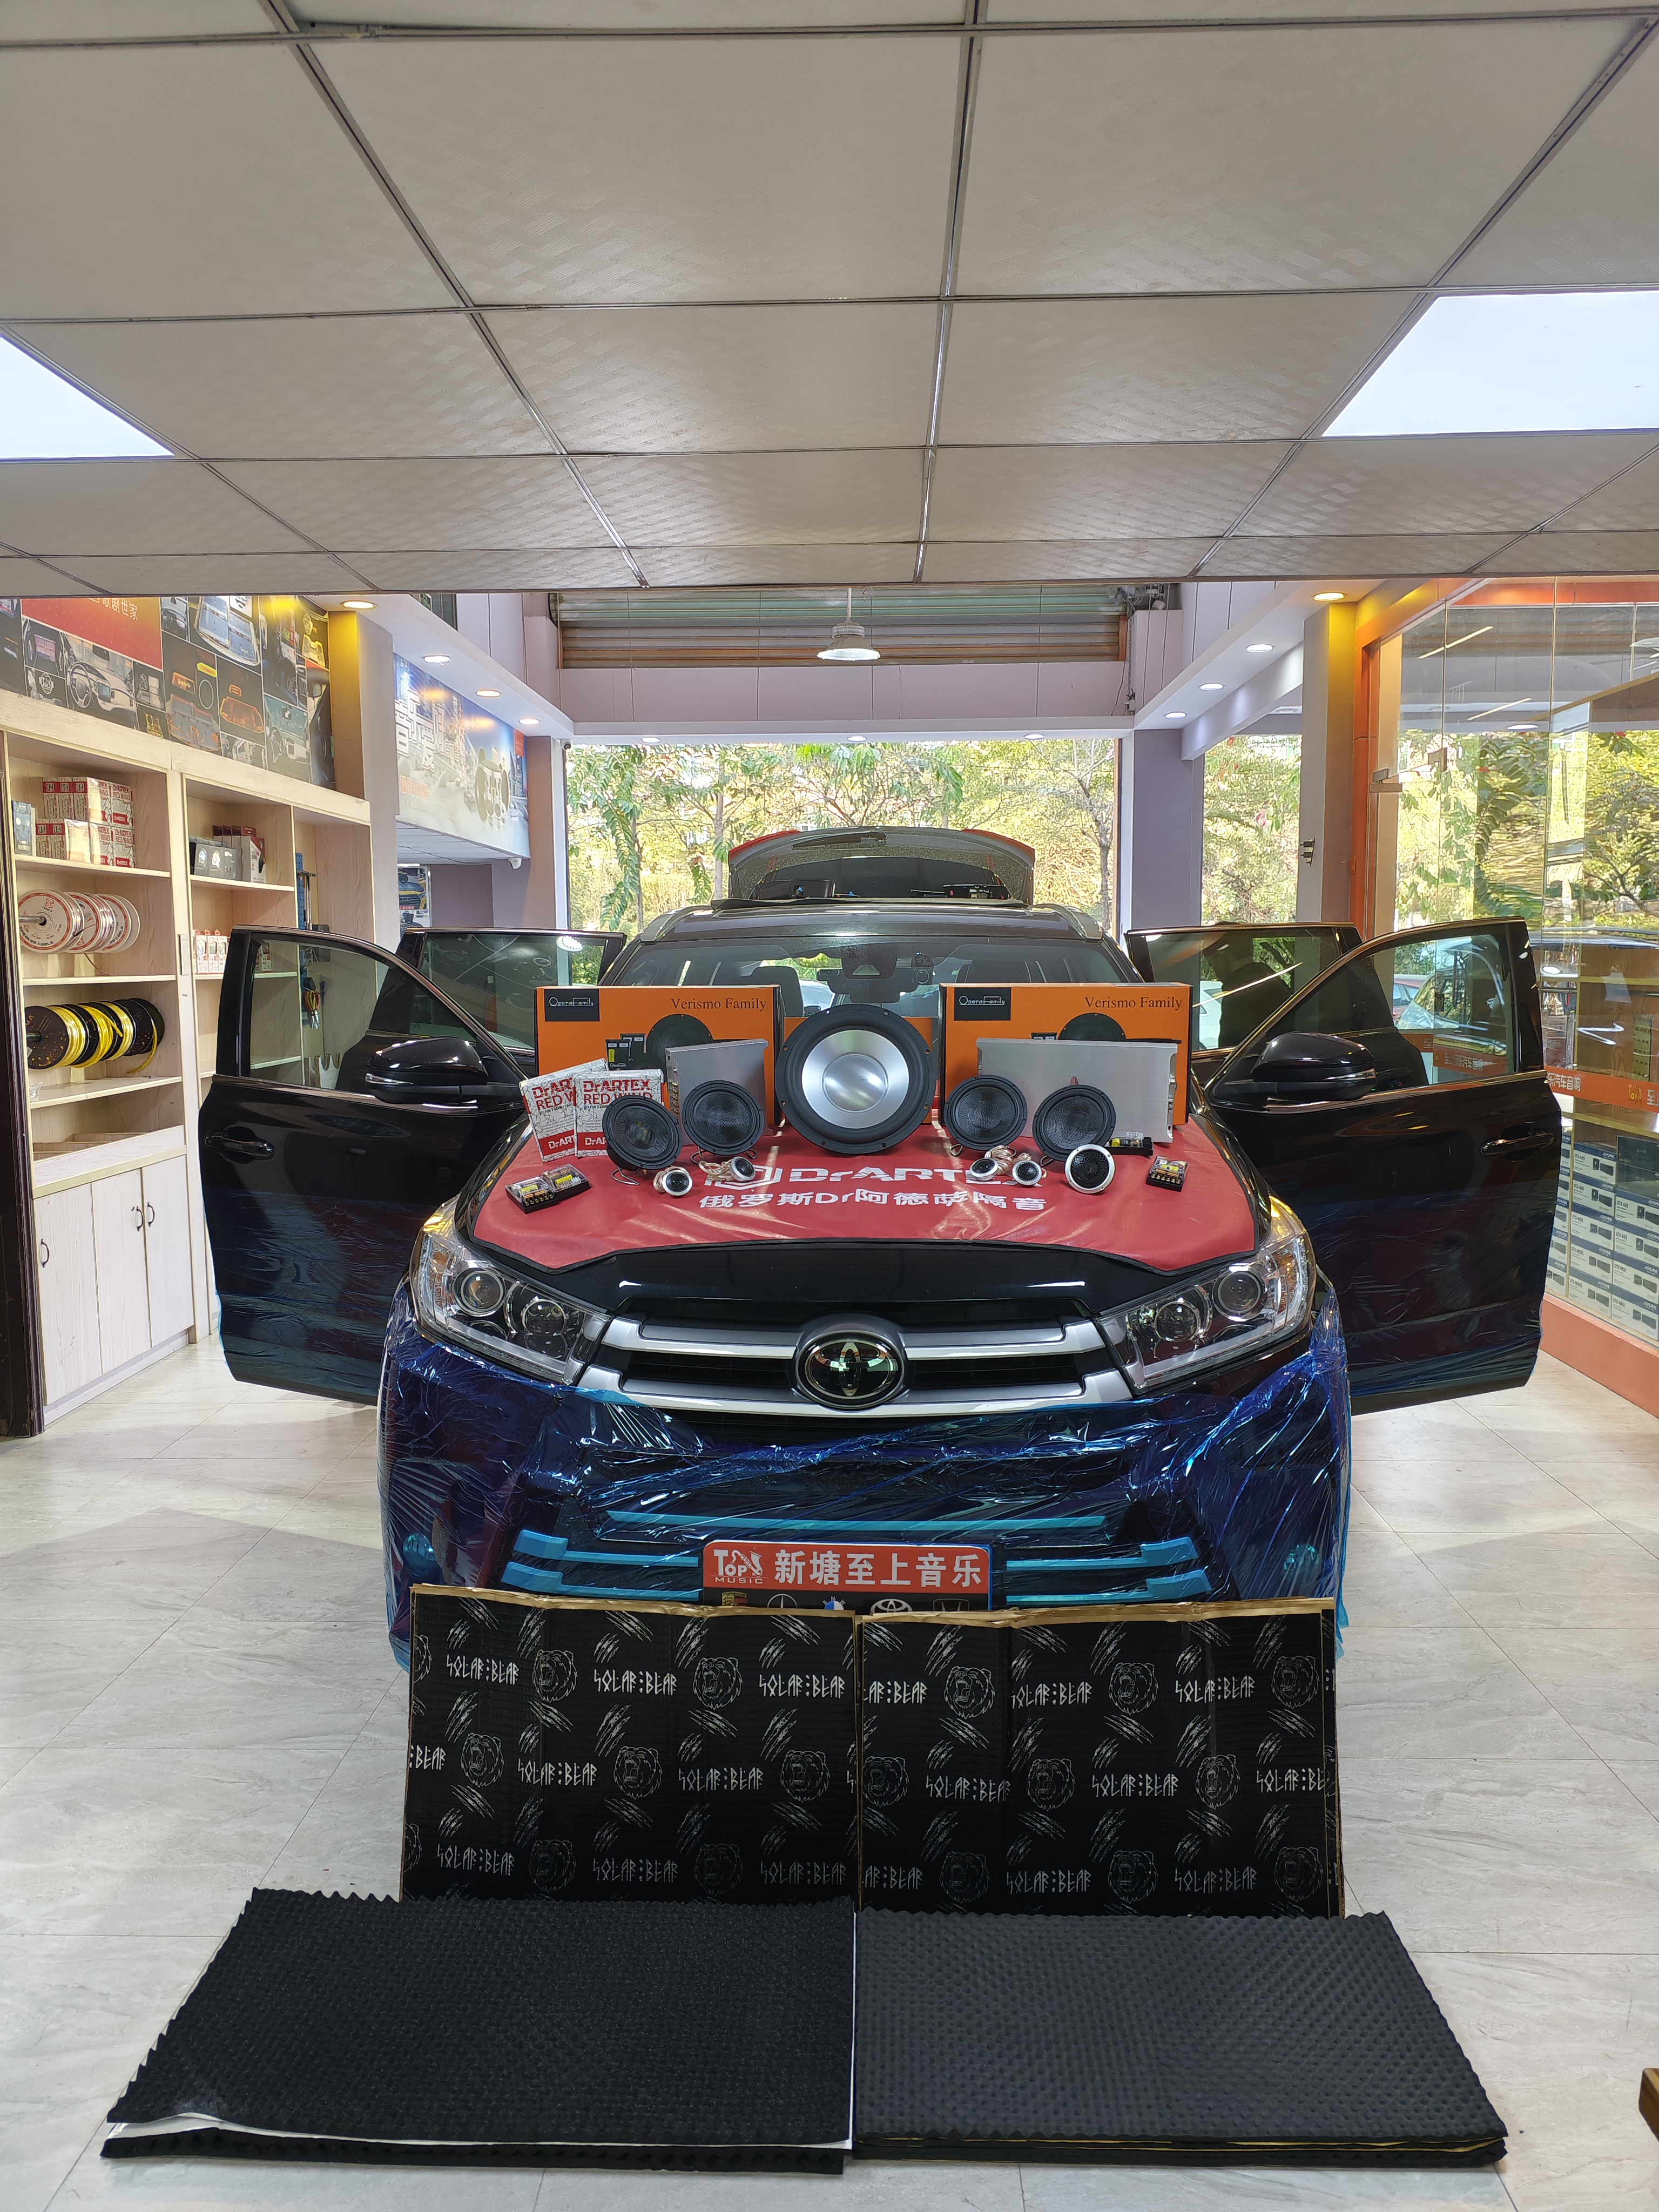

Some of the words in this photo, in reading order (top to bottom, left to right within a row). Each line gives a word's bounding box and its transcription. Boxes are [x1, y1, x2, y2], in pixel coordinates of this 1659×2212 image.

[88, 598, 138, 621] 歌剧世家
[671, 998, 721, 1009] Verismo
[725, 997, 767, 1013] Family
[1085, 996, 1136, 1009] Verismo
[1139, 996, 1183, 1011] Family
[583, 1079, 652, 1092] DrARTEX
[536, 1095, 563, 1111] RED
[584, 1093, 611, 1105] RED
[714, 1549, 748, 1576] TOP
[774, 1548, 982, 1588] 新塘至上音乐
[714, 1576, 764, 1584] MUSIC
